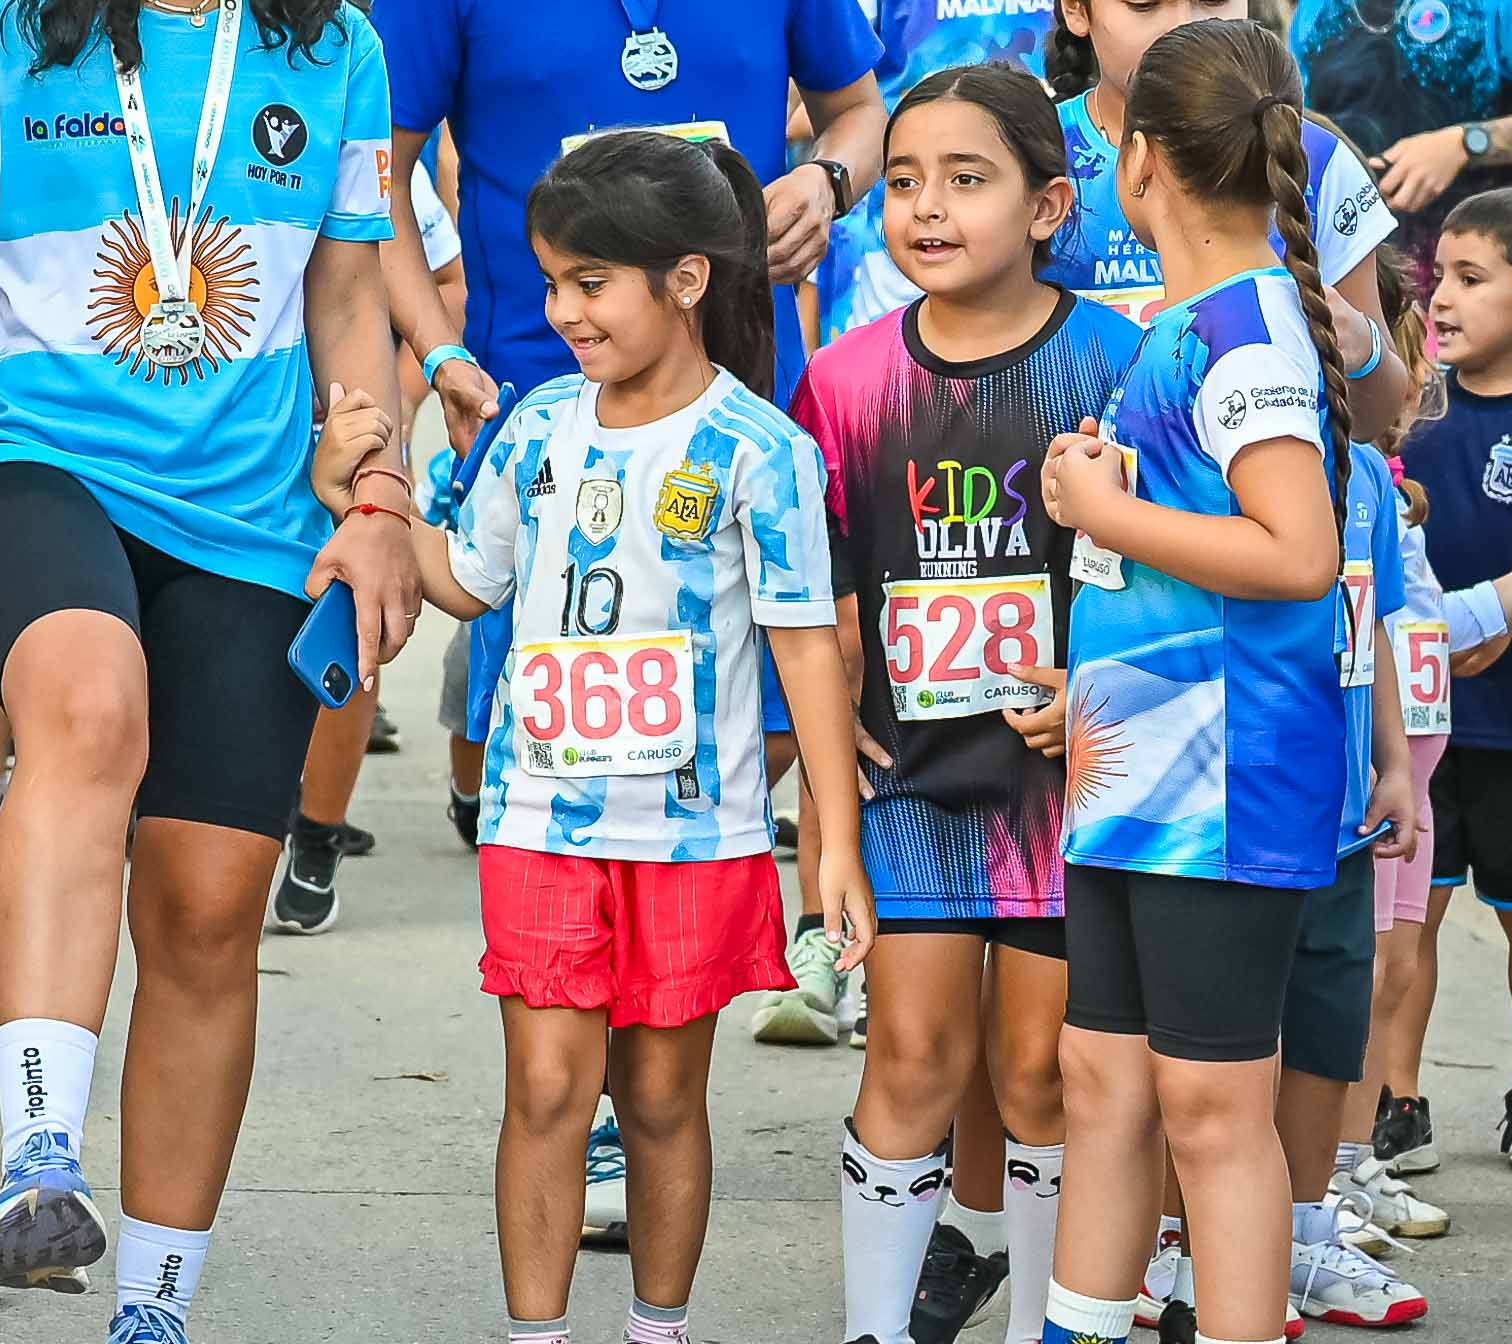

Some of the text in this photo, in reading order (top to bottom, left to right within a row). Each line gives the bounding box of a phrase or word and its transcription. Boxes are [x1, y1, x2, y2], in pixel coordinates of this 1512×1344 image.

[24, 112, 127, 140] la falda
[247, 164, 302, 190] HOY POR TI
[907, 458, 1028, 535] KIDS
[915, 517, 1031, 560] OLIVA
[919, 560, 978, 578] RUNNING
[559, 562, 624, 637] 10
[887, 591, 1039, 684] 528
[522, 648, 682, 742] 368
[984, 685, 1040, 699] CARUSO
[628, 747, 681, 761] CARUSO
[21, 1047, 49, 1119] riopinto
